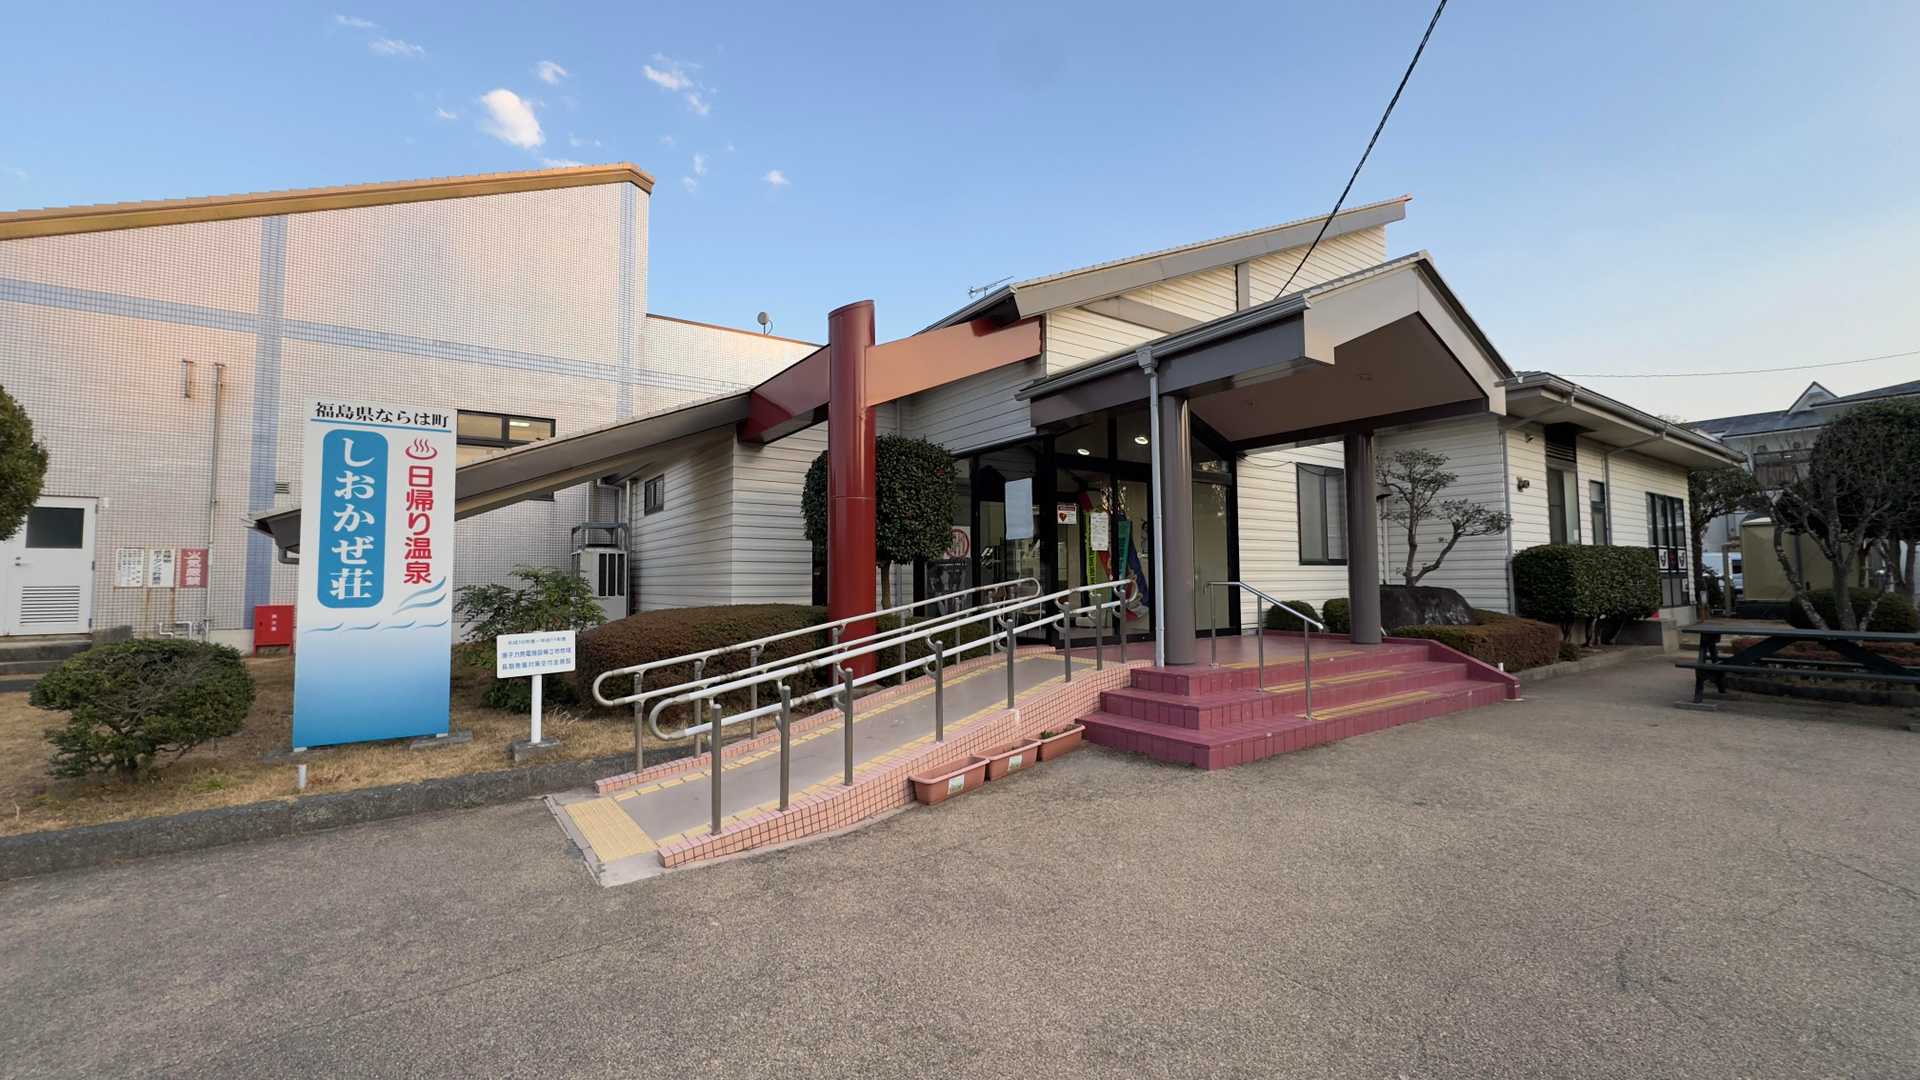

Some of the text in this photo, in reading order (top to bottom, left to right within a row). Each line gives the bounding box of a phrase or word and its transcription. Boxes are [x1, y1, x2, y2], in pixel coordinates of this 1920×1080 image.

[315, 401, 449, 428] 福島県ならは町
[329, 437, 376, 601] しおかぜ荘
[403, 465, 434, 585] 日帰り温泉
